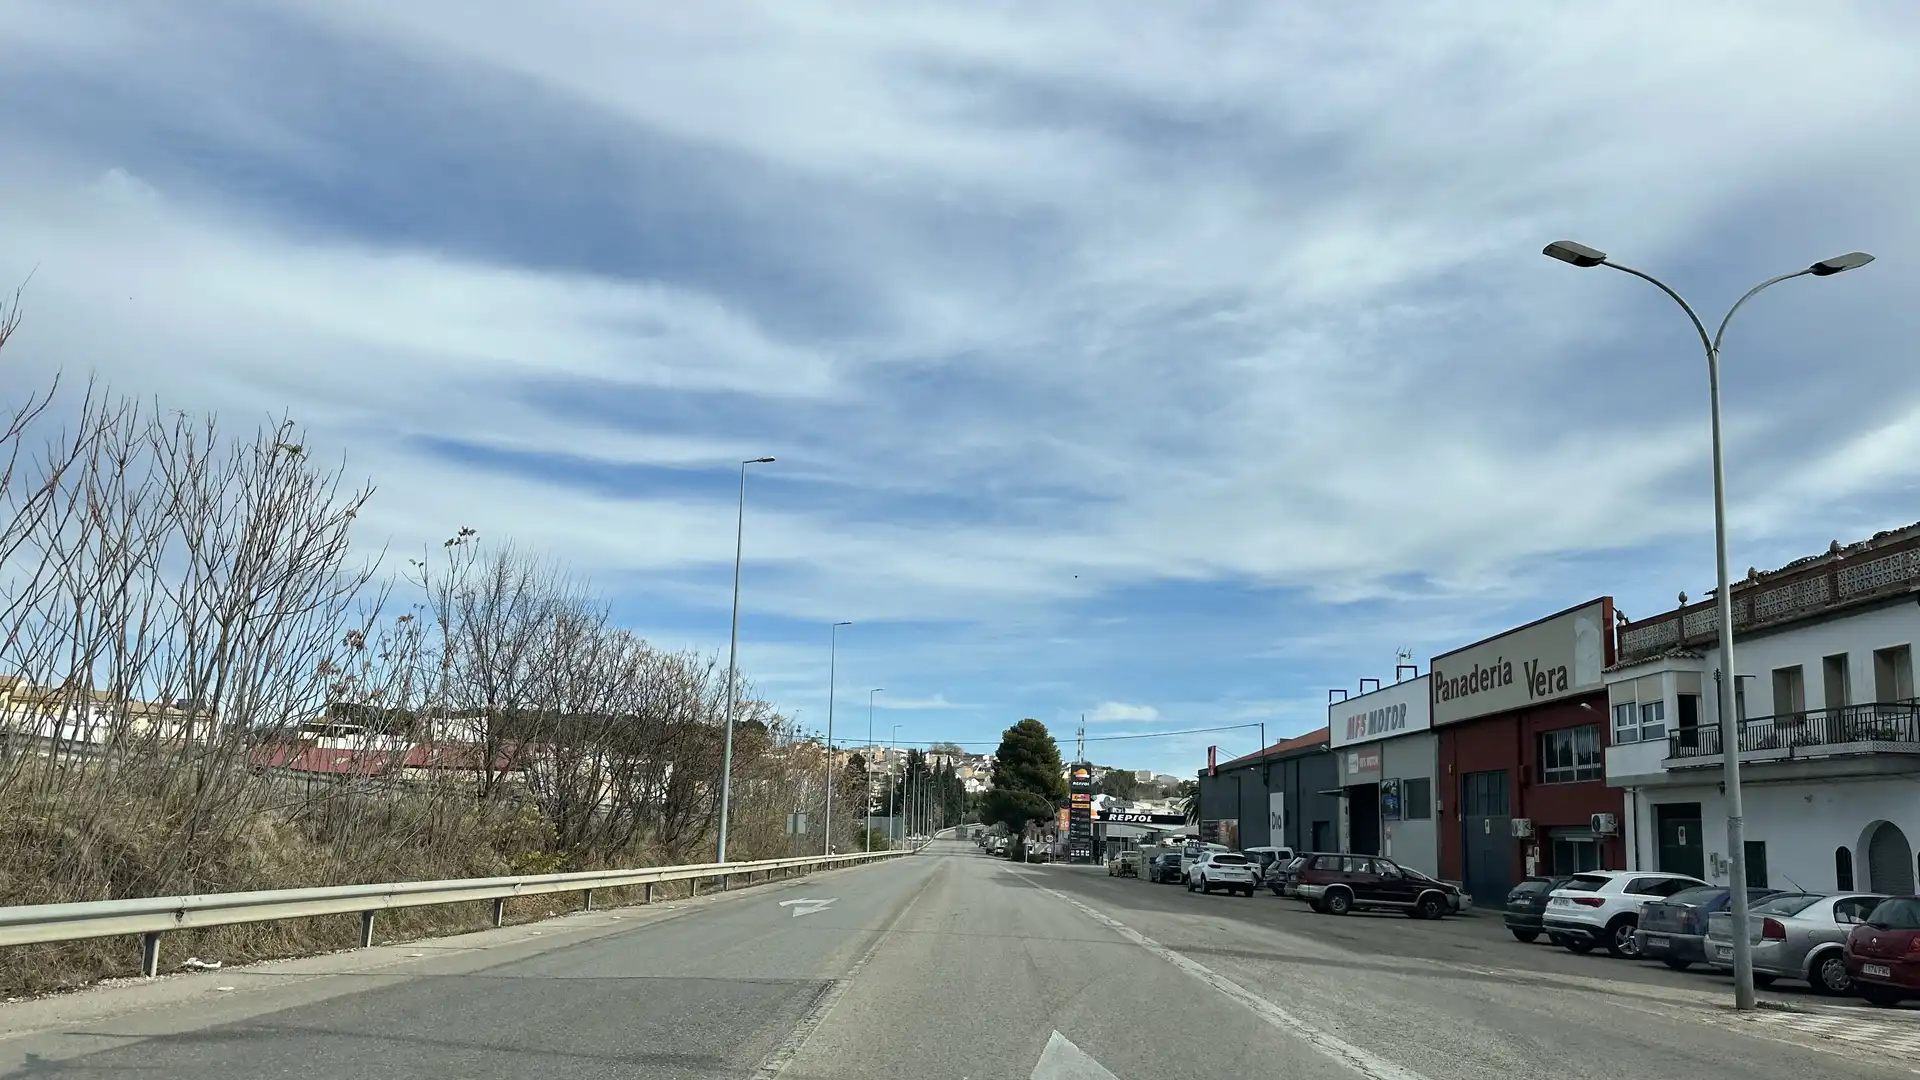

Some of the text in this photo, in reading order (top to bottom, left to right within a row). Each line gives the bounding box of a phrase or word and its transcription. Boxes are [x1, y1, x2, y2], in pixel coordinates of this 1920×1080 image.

[1434, 656, 1569, 704] Panadería Vera
[1346, 702, 1407, 740] MFS MOTOR
[1108, 813, 1153, 823] REPSOL
